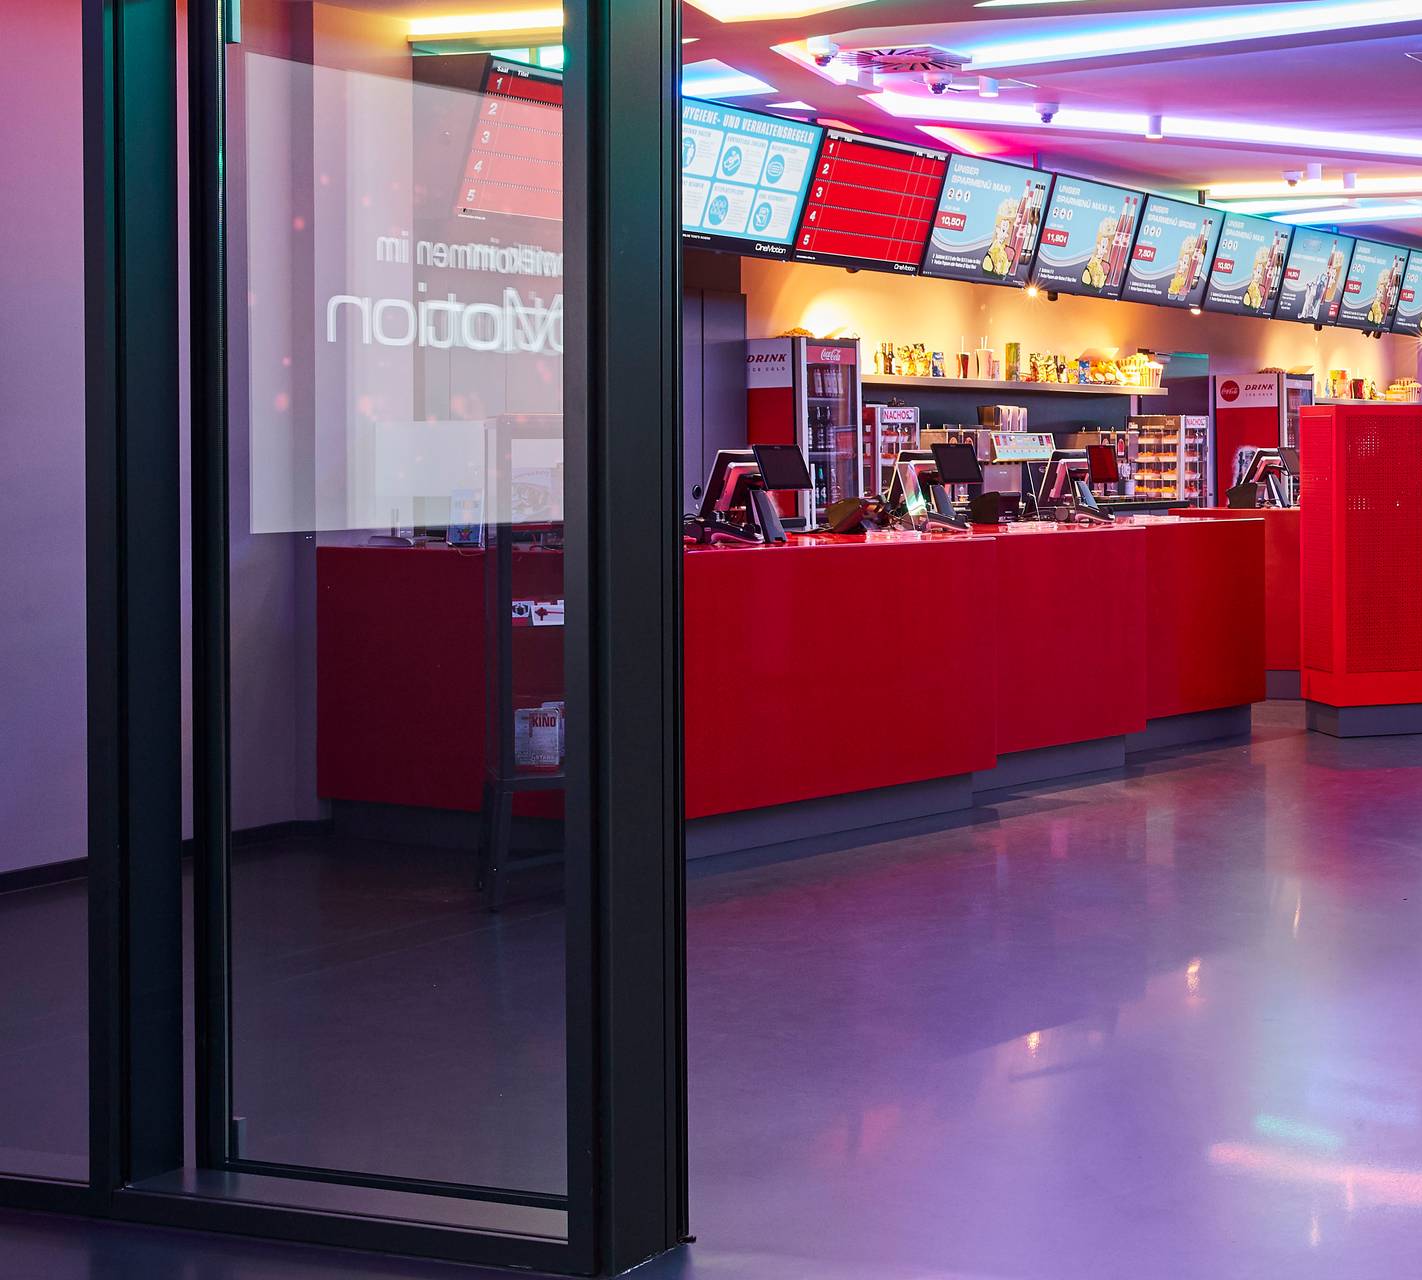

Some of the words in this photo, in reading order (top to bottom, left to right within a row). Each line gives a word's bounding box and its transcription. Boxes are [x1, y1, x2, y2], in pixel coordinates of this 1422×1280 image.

[497, 65, 509, 73] Saal
[517, 69, 530, 78] Titel
[495, 77, 503, 90] 1
[488, 102, 498, 116] 2
[683, 105, 720, 123] HYGIENE-
[722, 114, 740, 129] UND
[742, 117, 815, 145] VERHALTENSREGELN
[481, 130, 490, 144] 3
[828, 143, 834, 153] 1
[474, 160, 483, 174] 4
[822, 163, 830, 175] 2
[466, 188, 476, 202] 5
[815, 186, 823, 198] 3
[809, 210, 817, 222] 4
[802, 234, 811, 245] 5
[755, 243, 787, 254] CineMotion
[746, 353, 787, 364] DRINK
[883, 408, 909, 420] NACHOS
[533, 716, 557, 728] KINO
